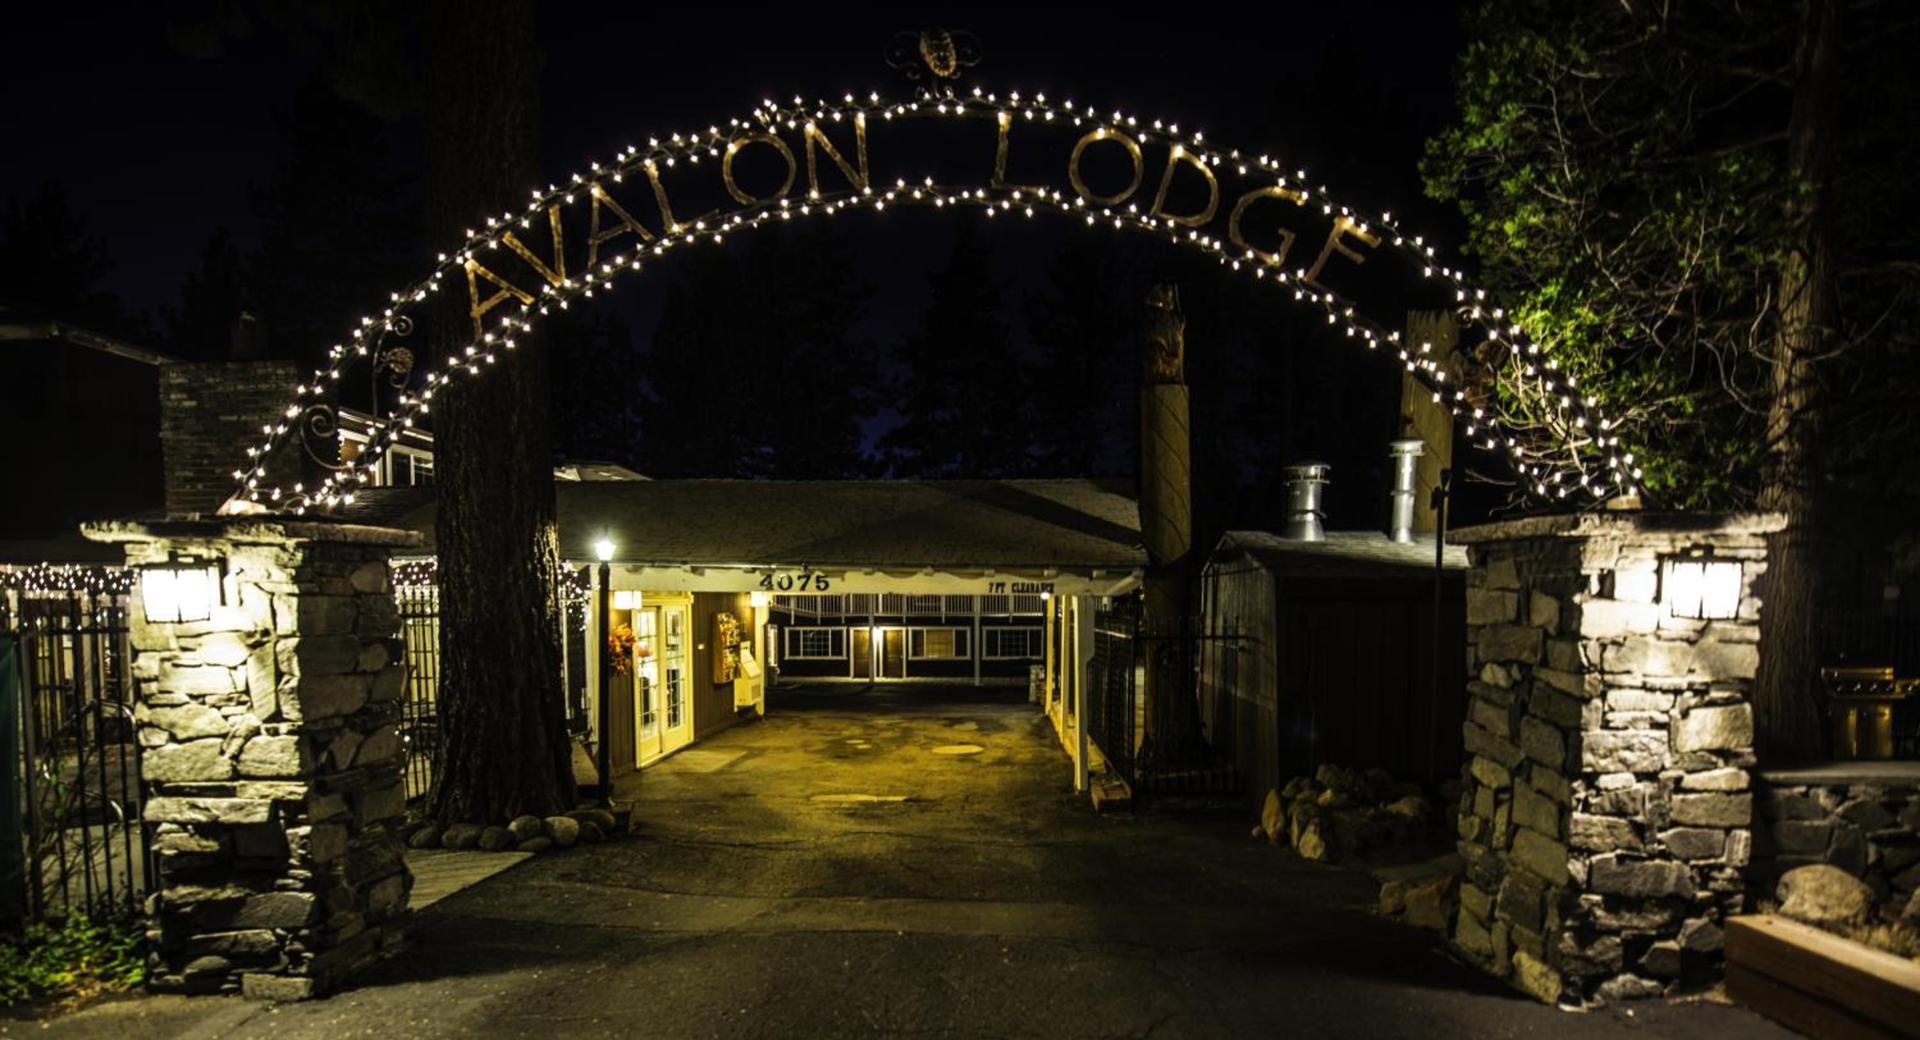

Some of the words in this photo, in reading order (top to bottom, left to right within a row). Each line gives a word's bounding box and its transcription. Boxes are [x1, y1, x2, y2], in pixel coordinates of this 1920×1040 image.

[463, 111, 870, 341] AVALON
[990, 110, 1381, 304] LODGE
[759, 573, 830, 592] 4075
[988, 582, 995, 594] 7
[995, 582, 1006, 594] FT
